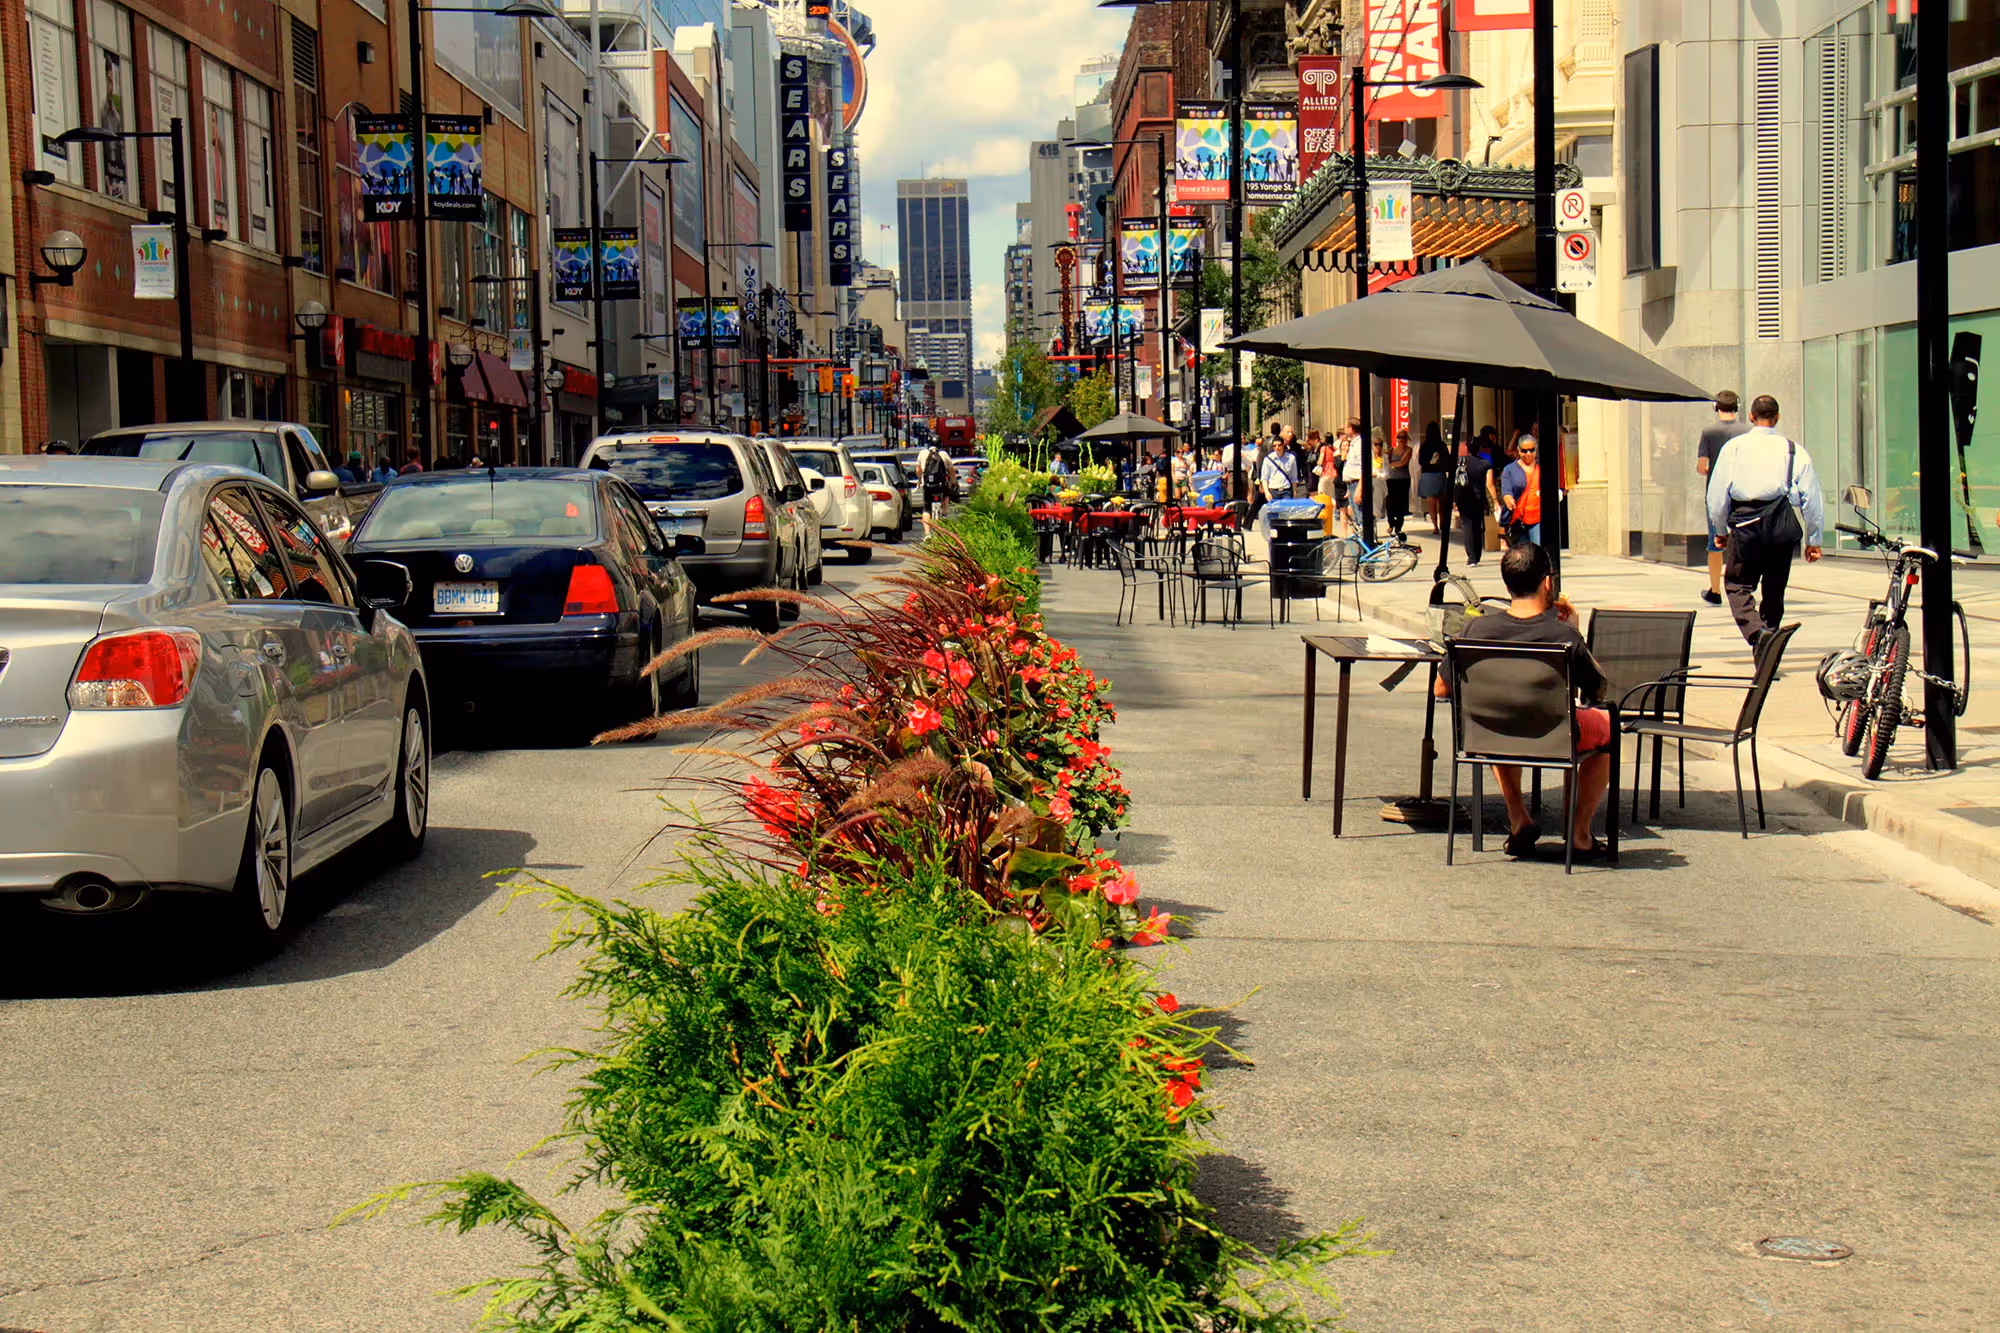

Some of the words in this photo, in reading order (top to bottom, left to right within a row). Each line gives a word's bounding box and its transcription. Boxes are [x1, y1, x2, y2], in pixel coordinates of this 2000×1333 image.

[1303, 97, 1337, 105] ALLIED
[785, 59, 807, 198] SEARS
[1038, 143, 1060, 157] 415
[1246, 183, 1259, 191] 195
[1260, 183, 1283, 193] Yonge
[1283, 183, 1294, 191] St.
[376, 201, 402, 214] KOY
[433, 200, 476, 209] koydeals.com
[831, 151, 847, 260] SEARS
[564, 287, 584, 296] KOY
